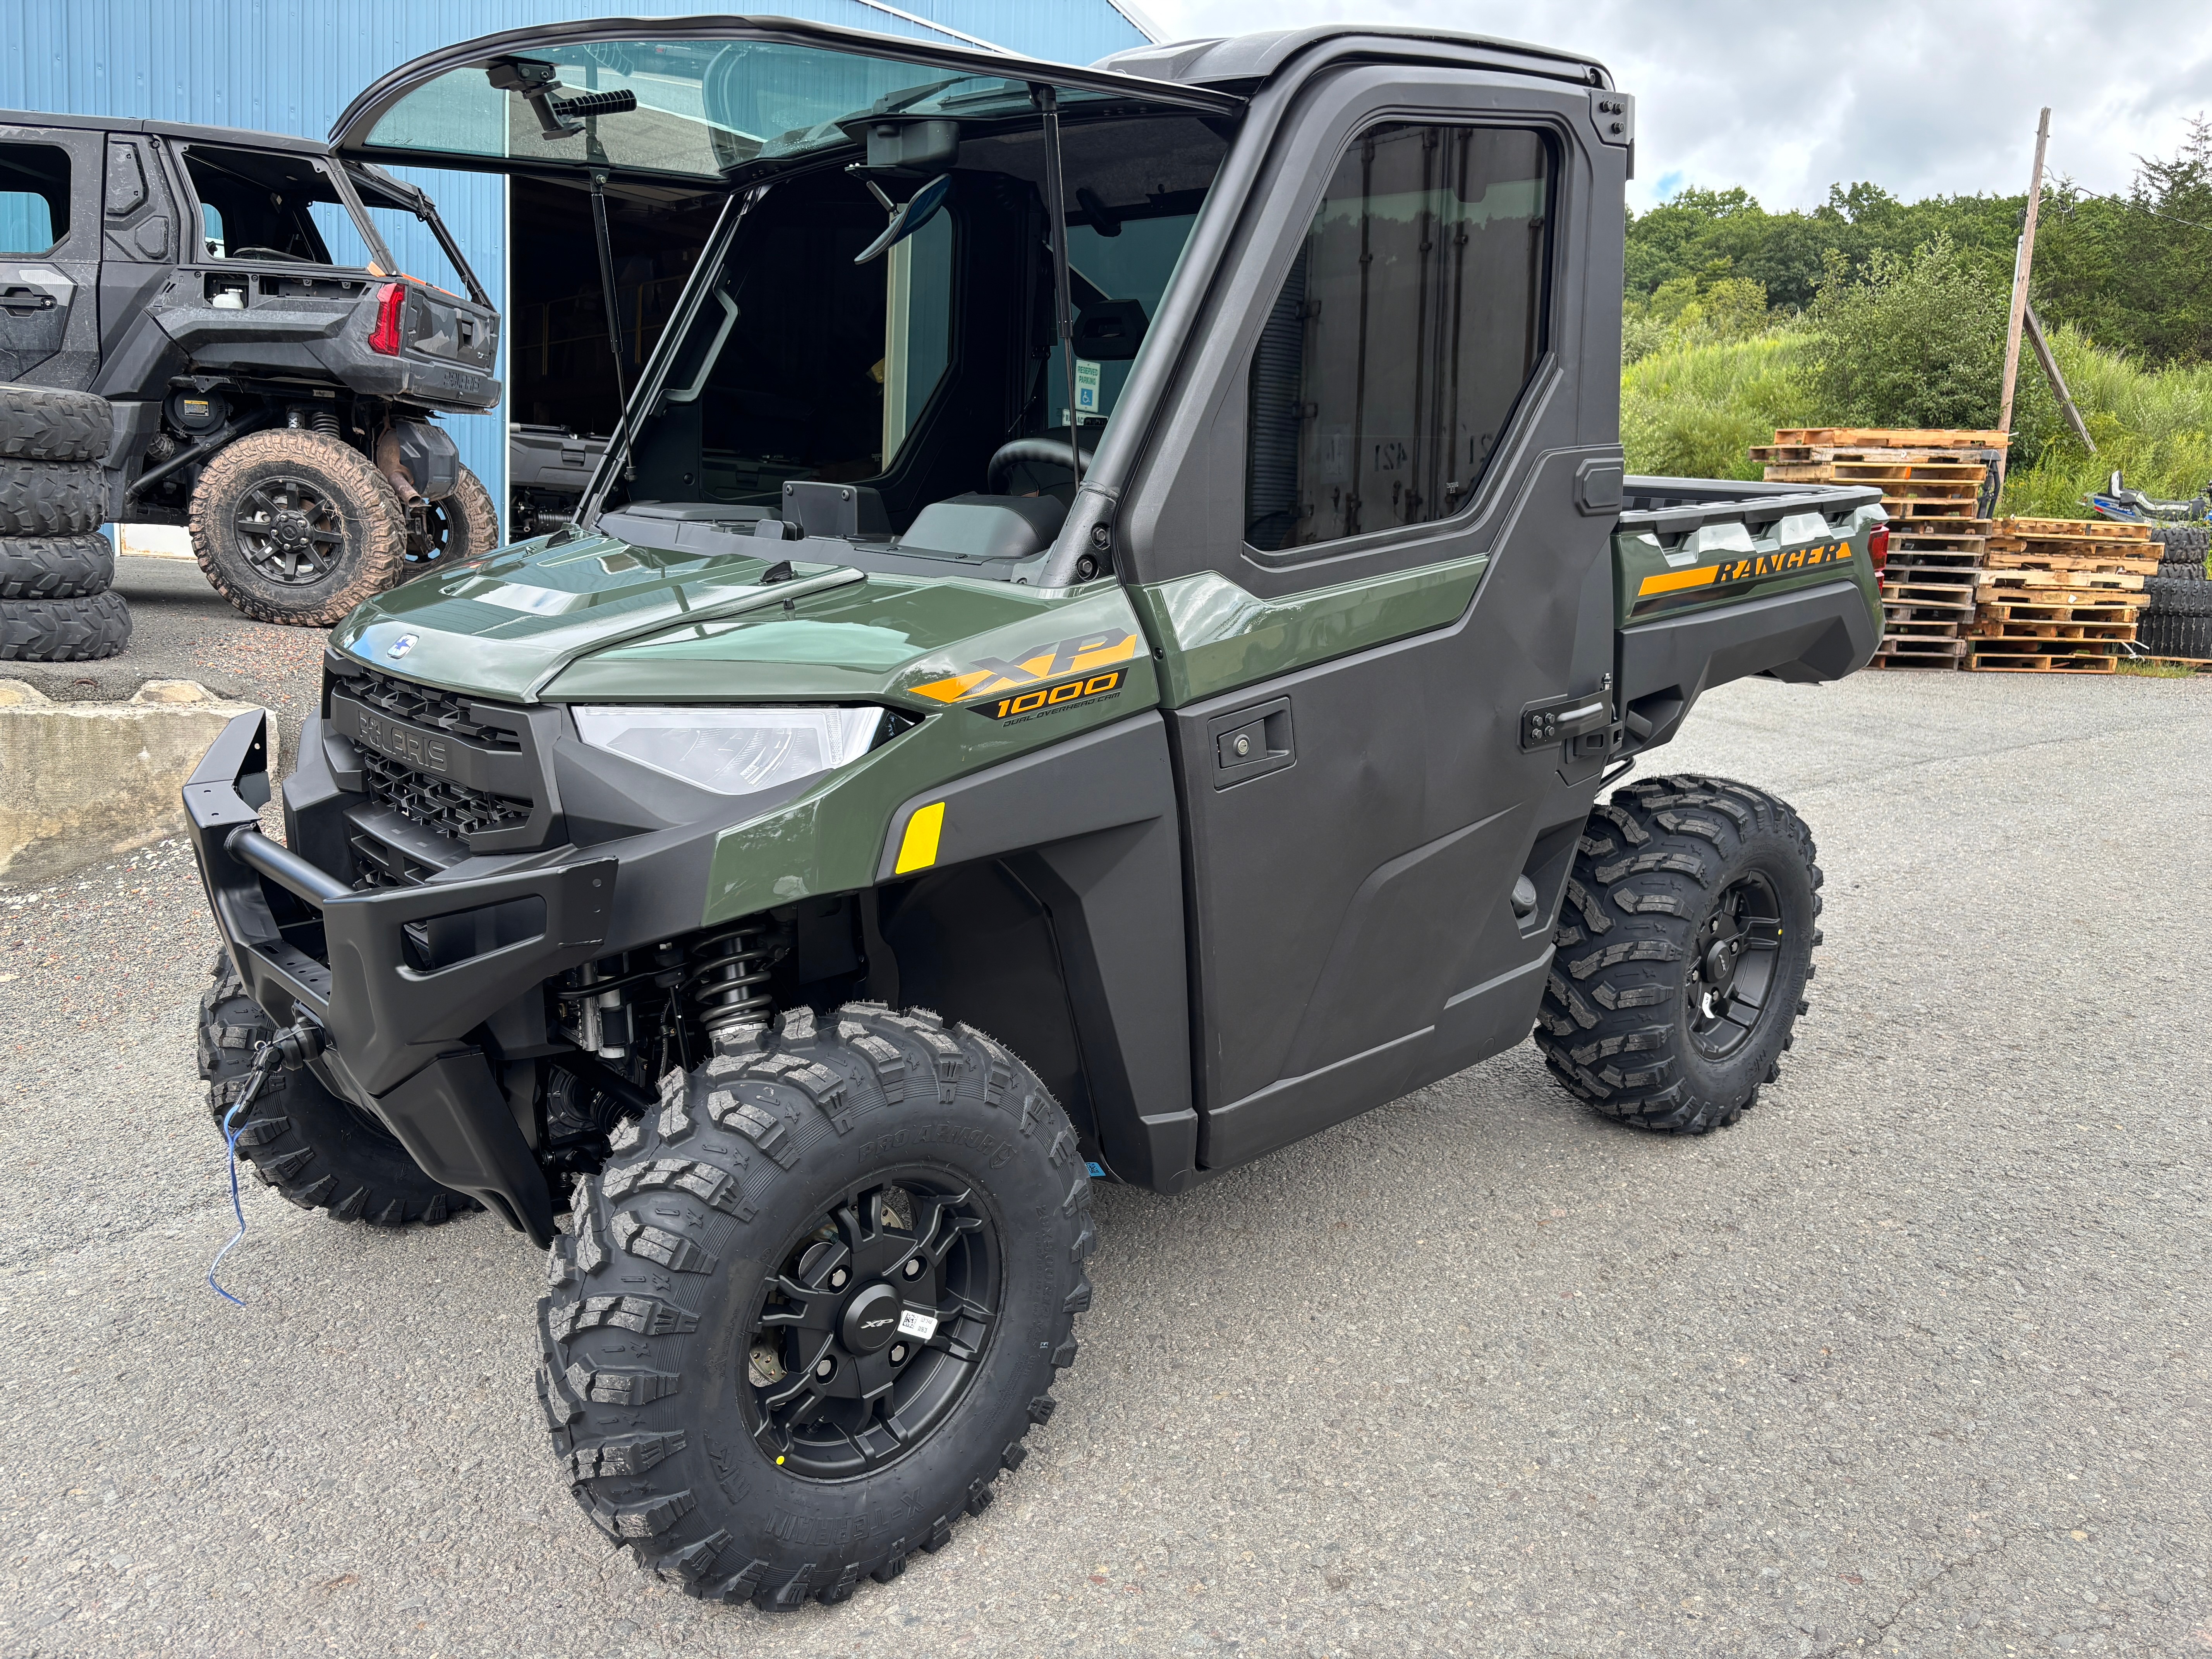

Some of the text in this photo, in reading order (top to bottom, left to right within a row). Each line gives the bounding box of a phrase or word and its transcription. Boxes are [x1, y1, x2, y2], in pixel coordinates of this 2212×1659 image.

[443, 371, 480, 392] POLARIS
[1078, 366, 1098, 376] RESERVED
[1079, 376, 1096, 385] PARKING
[1712, 542, 1841, 585] RANGER
[945, 627, 1132, 701] XP
[997, 672, 1118, 718] 1000
[1002, 691, 1121, 728] DUAL OVERHEAD CAM
[358, 710, 448, 771] POLARIS
[858, 1124, 996, 1163] PRO ARMOR
[860, 1318, 895, 1329] XP
[764, 1486, 926, 1546] X-TERRAIN
